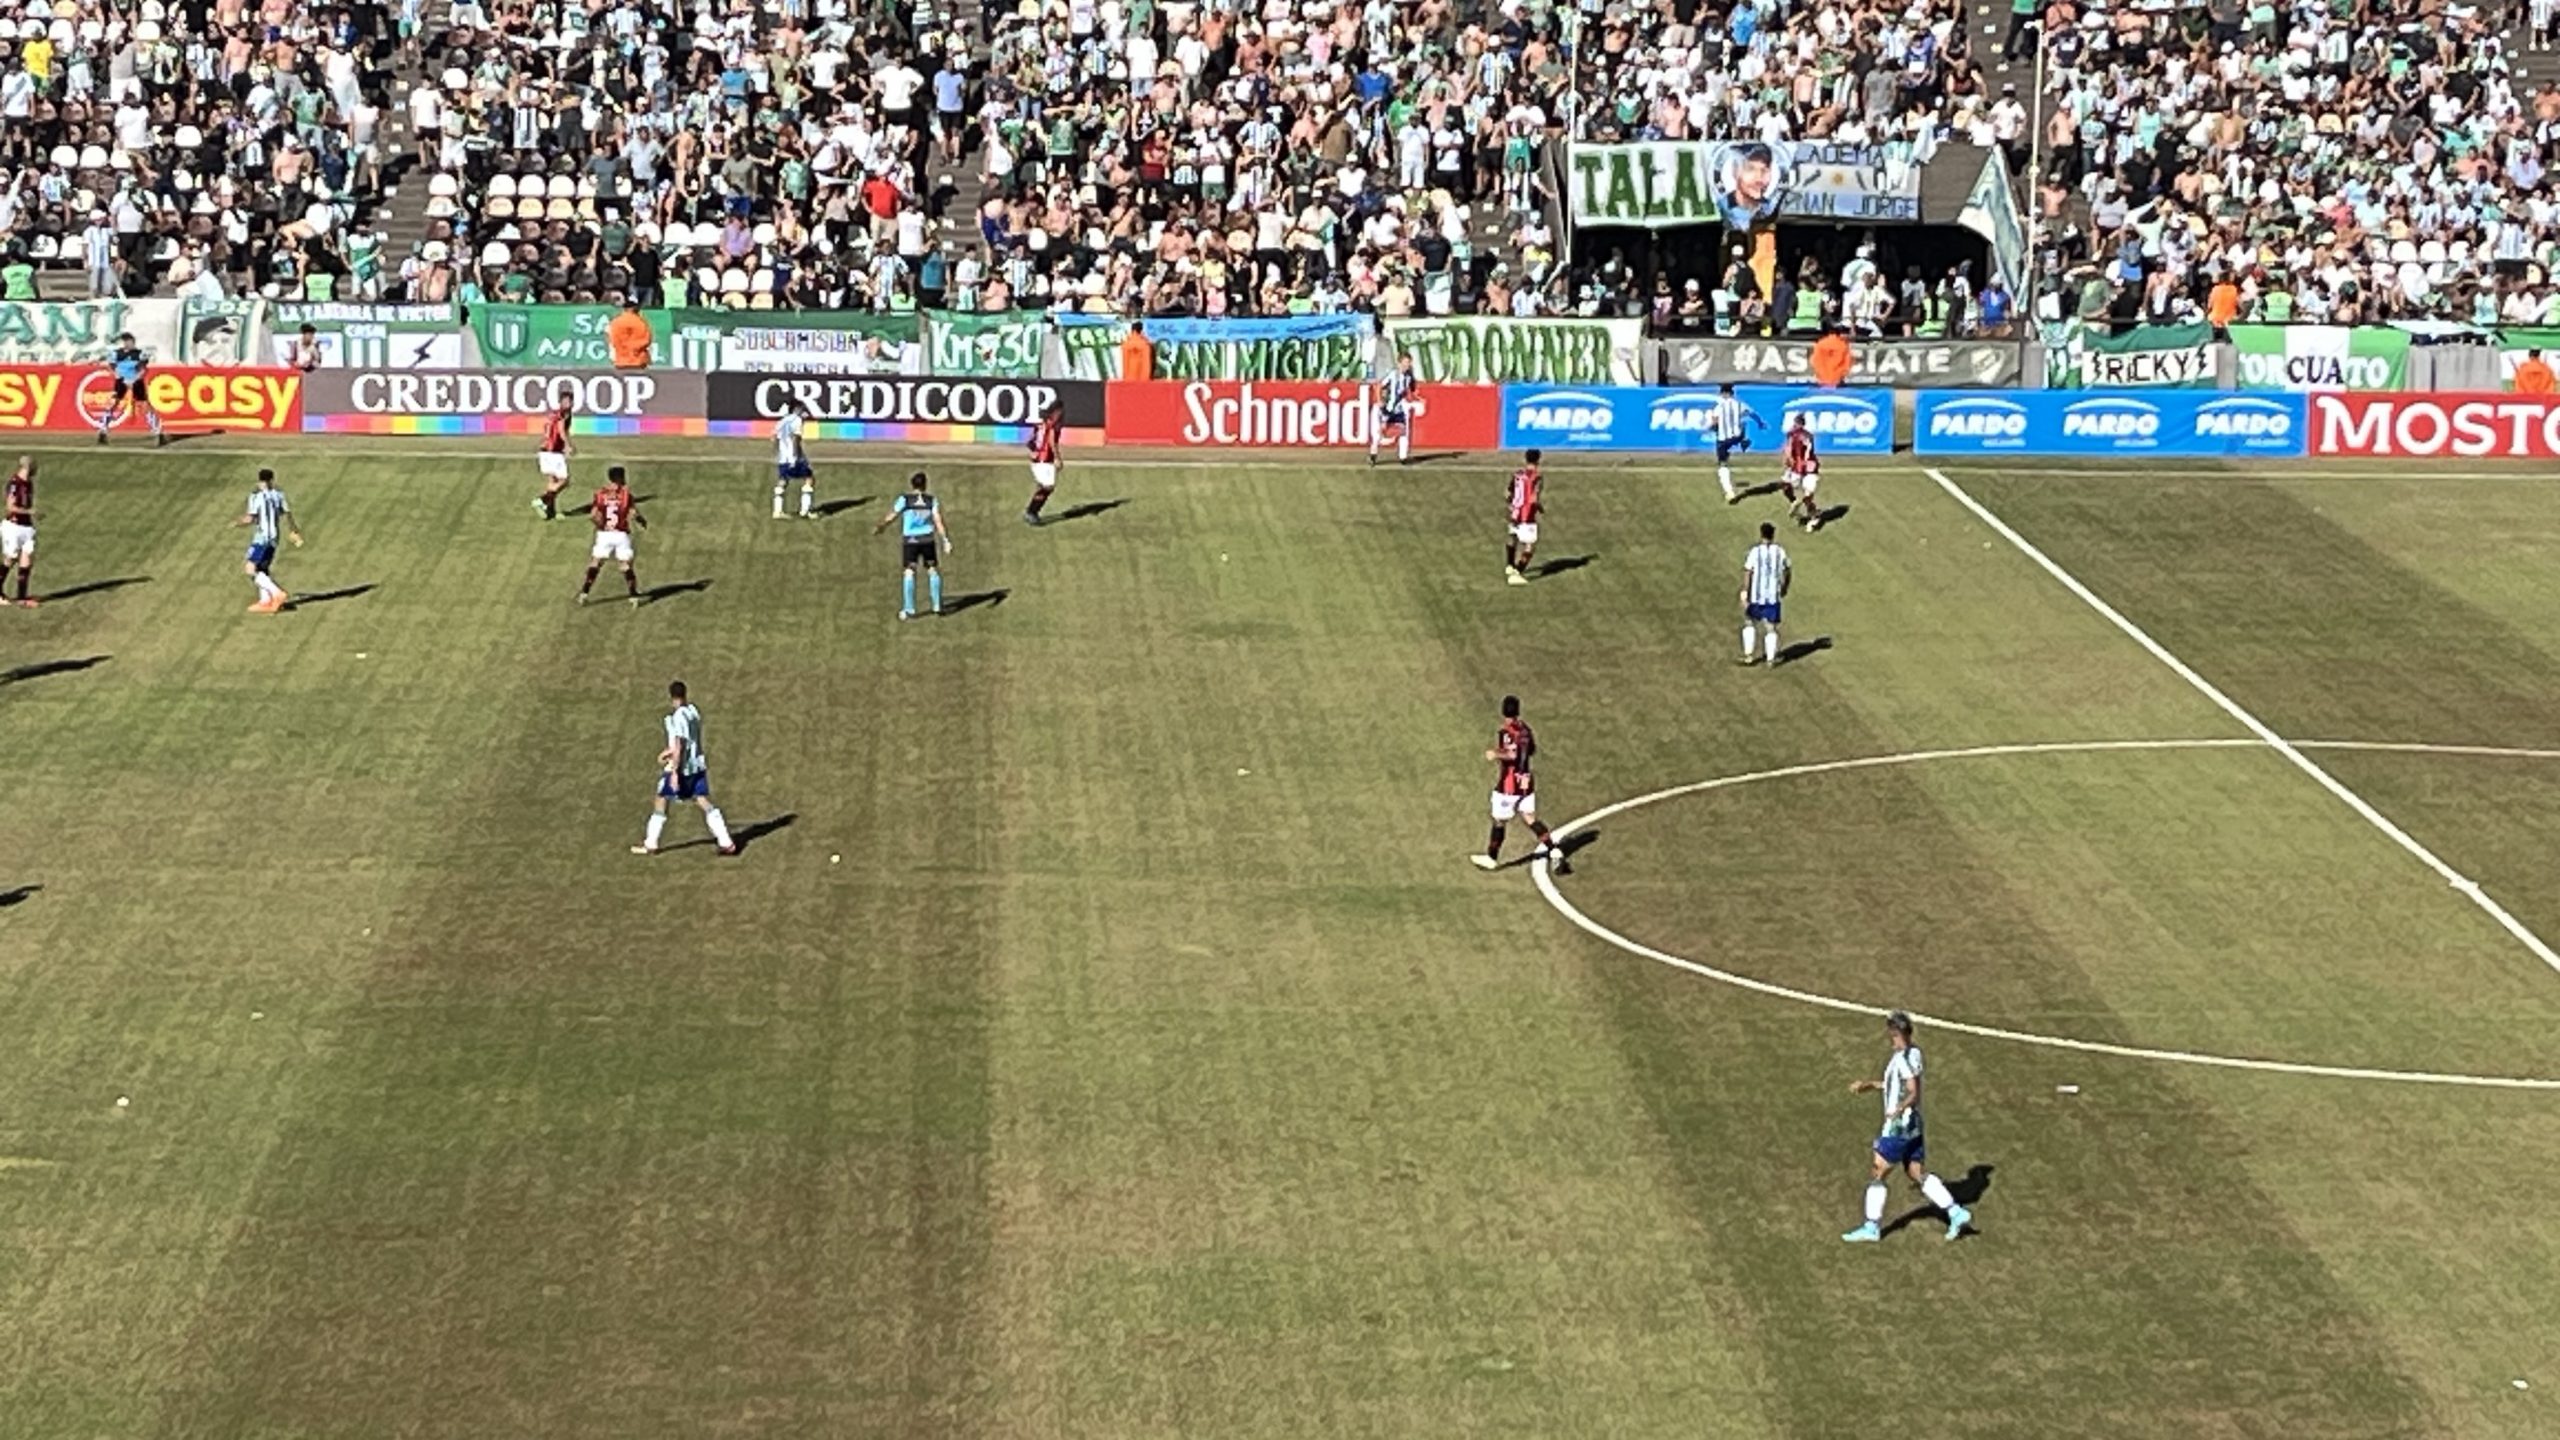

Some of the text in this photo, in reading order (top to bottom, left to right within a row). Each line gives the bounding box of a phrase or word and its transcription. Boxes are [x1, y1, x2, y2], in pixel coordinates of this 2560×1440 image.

[1575, 151, 1716, 217] TALA
[1732, 344, 1951, 373] #ASCIATE
[148, 373, 300, 429] easy
[351, 373, 655, 415] CREDICOOP
[754, 379, 1058, 424] CREDICOOP
[1517, 406, 1613, 430] PARDO
[1650, 407, 1714, 430] PAR
[1930, 413, 2028, 436] PARDO
[2063, 413, 2160, 436] PARDO
[2195, 413, 2292, 436] PARDO
